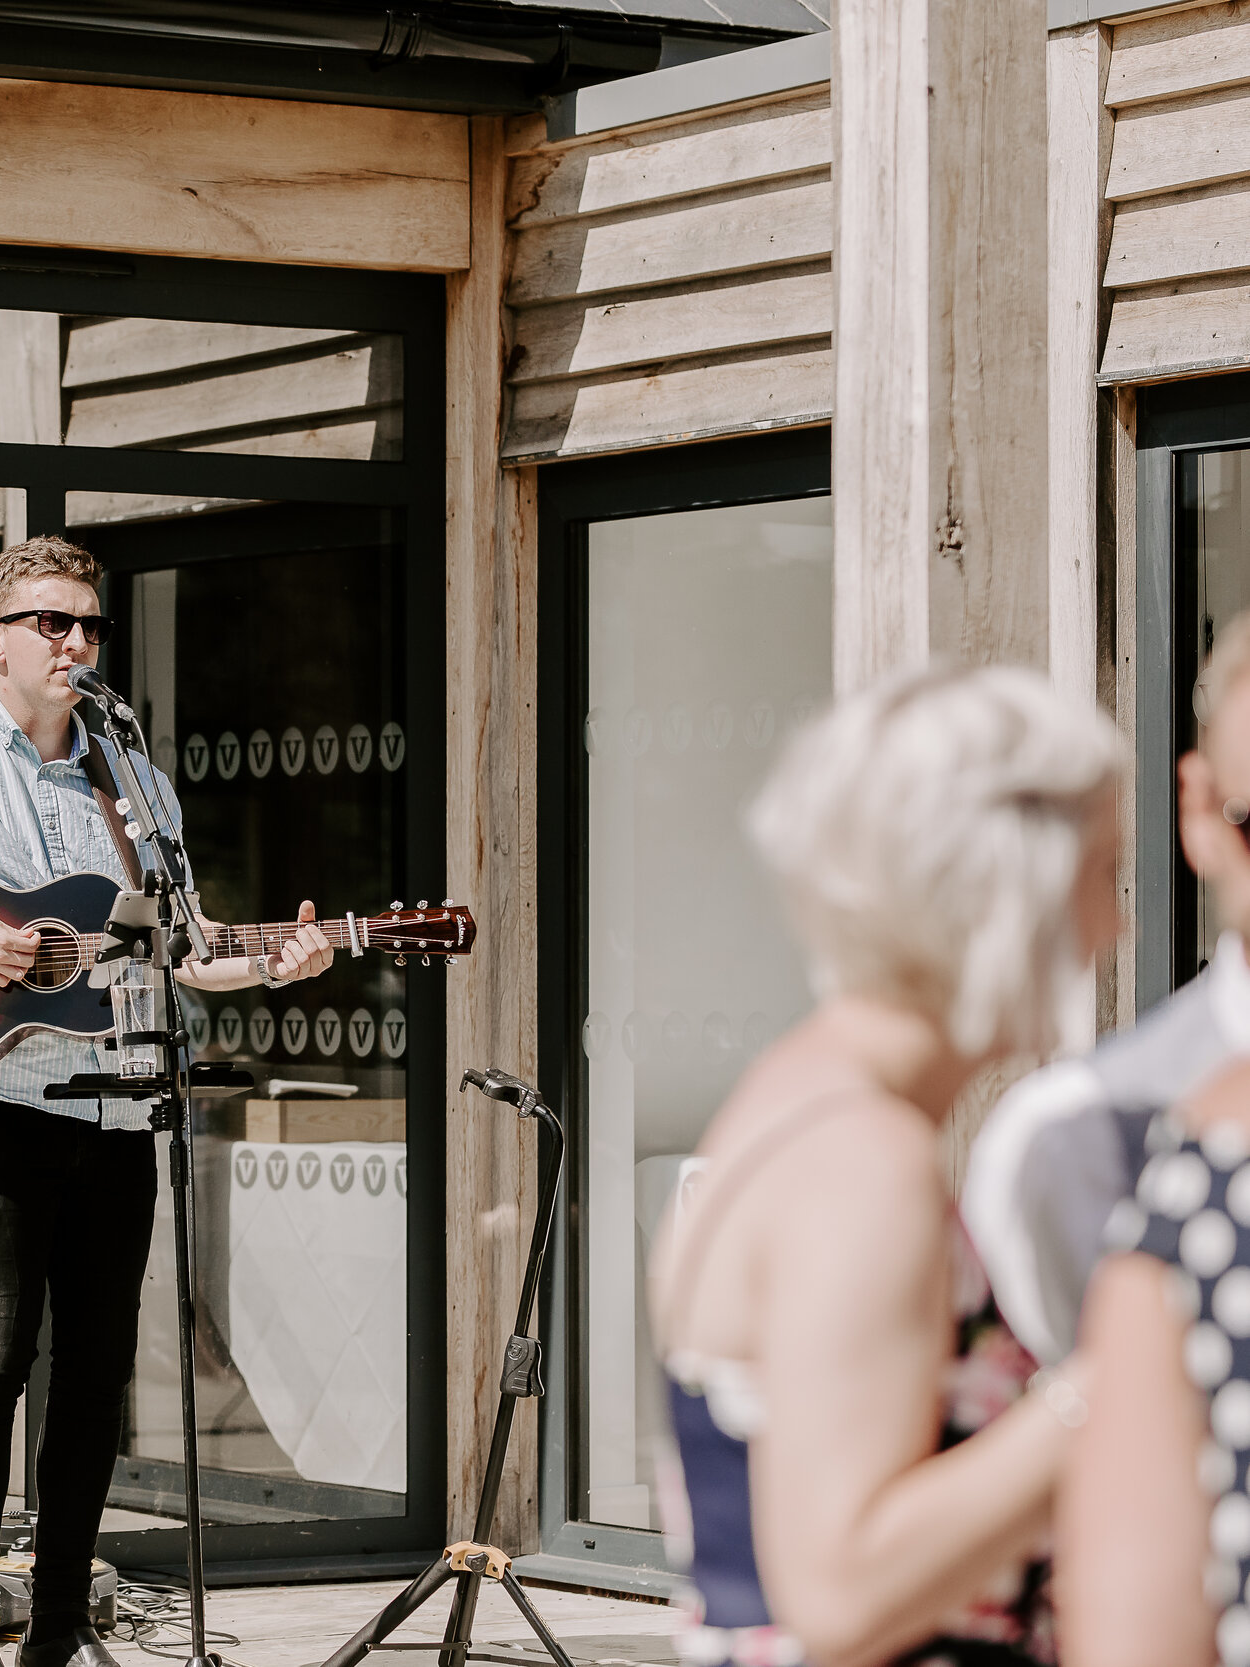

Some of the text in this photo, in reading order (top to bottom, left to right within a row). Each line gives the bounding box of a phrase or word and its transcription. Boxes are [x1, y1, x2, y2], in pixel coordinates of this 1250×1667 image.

[188, 734, 402, 774] V V V V V V V
[190, 1018, 404, 1049] V V V V V V V
[237, 1158, 256, 1183] V
[268, 1160, 286, 1185] V
[300, 1160, 319, 1185] V
[333, 1162, 352, 1188] V
[366, 1162, 385, 1190] V
